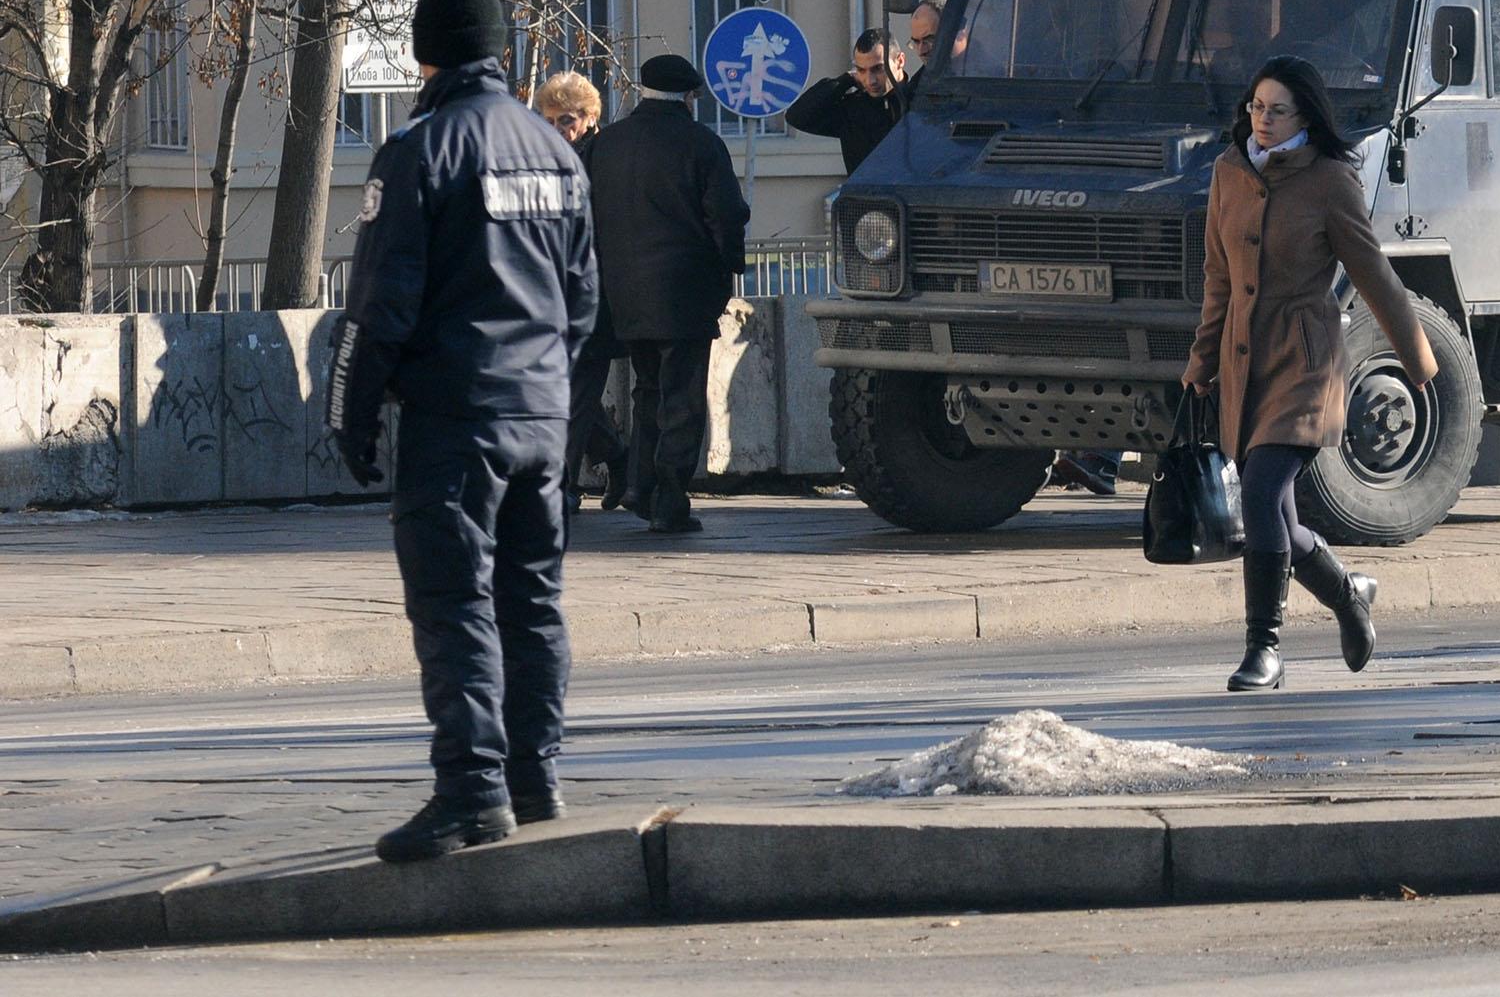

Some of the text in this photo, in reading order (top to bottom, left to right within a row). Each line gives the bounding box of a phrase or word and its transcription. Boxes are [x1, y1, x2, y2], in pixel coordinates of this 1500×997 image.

[382, 67, 399, 81] 100
[1012, 189, 1087, 207] IVECO
[993, 266, 1020, 290] CA
[1026, 268, 1076, 292] 1576
[1079, 269, 1107, 293] TM
[330, 320, 359, 430] SECURITY POLICE
